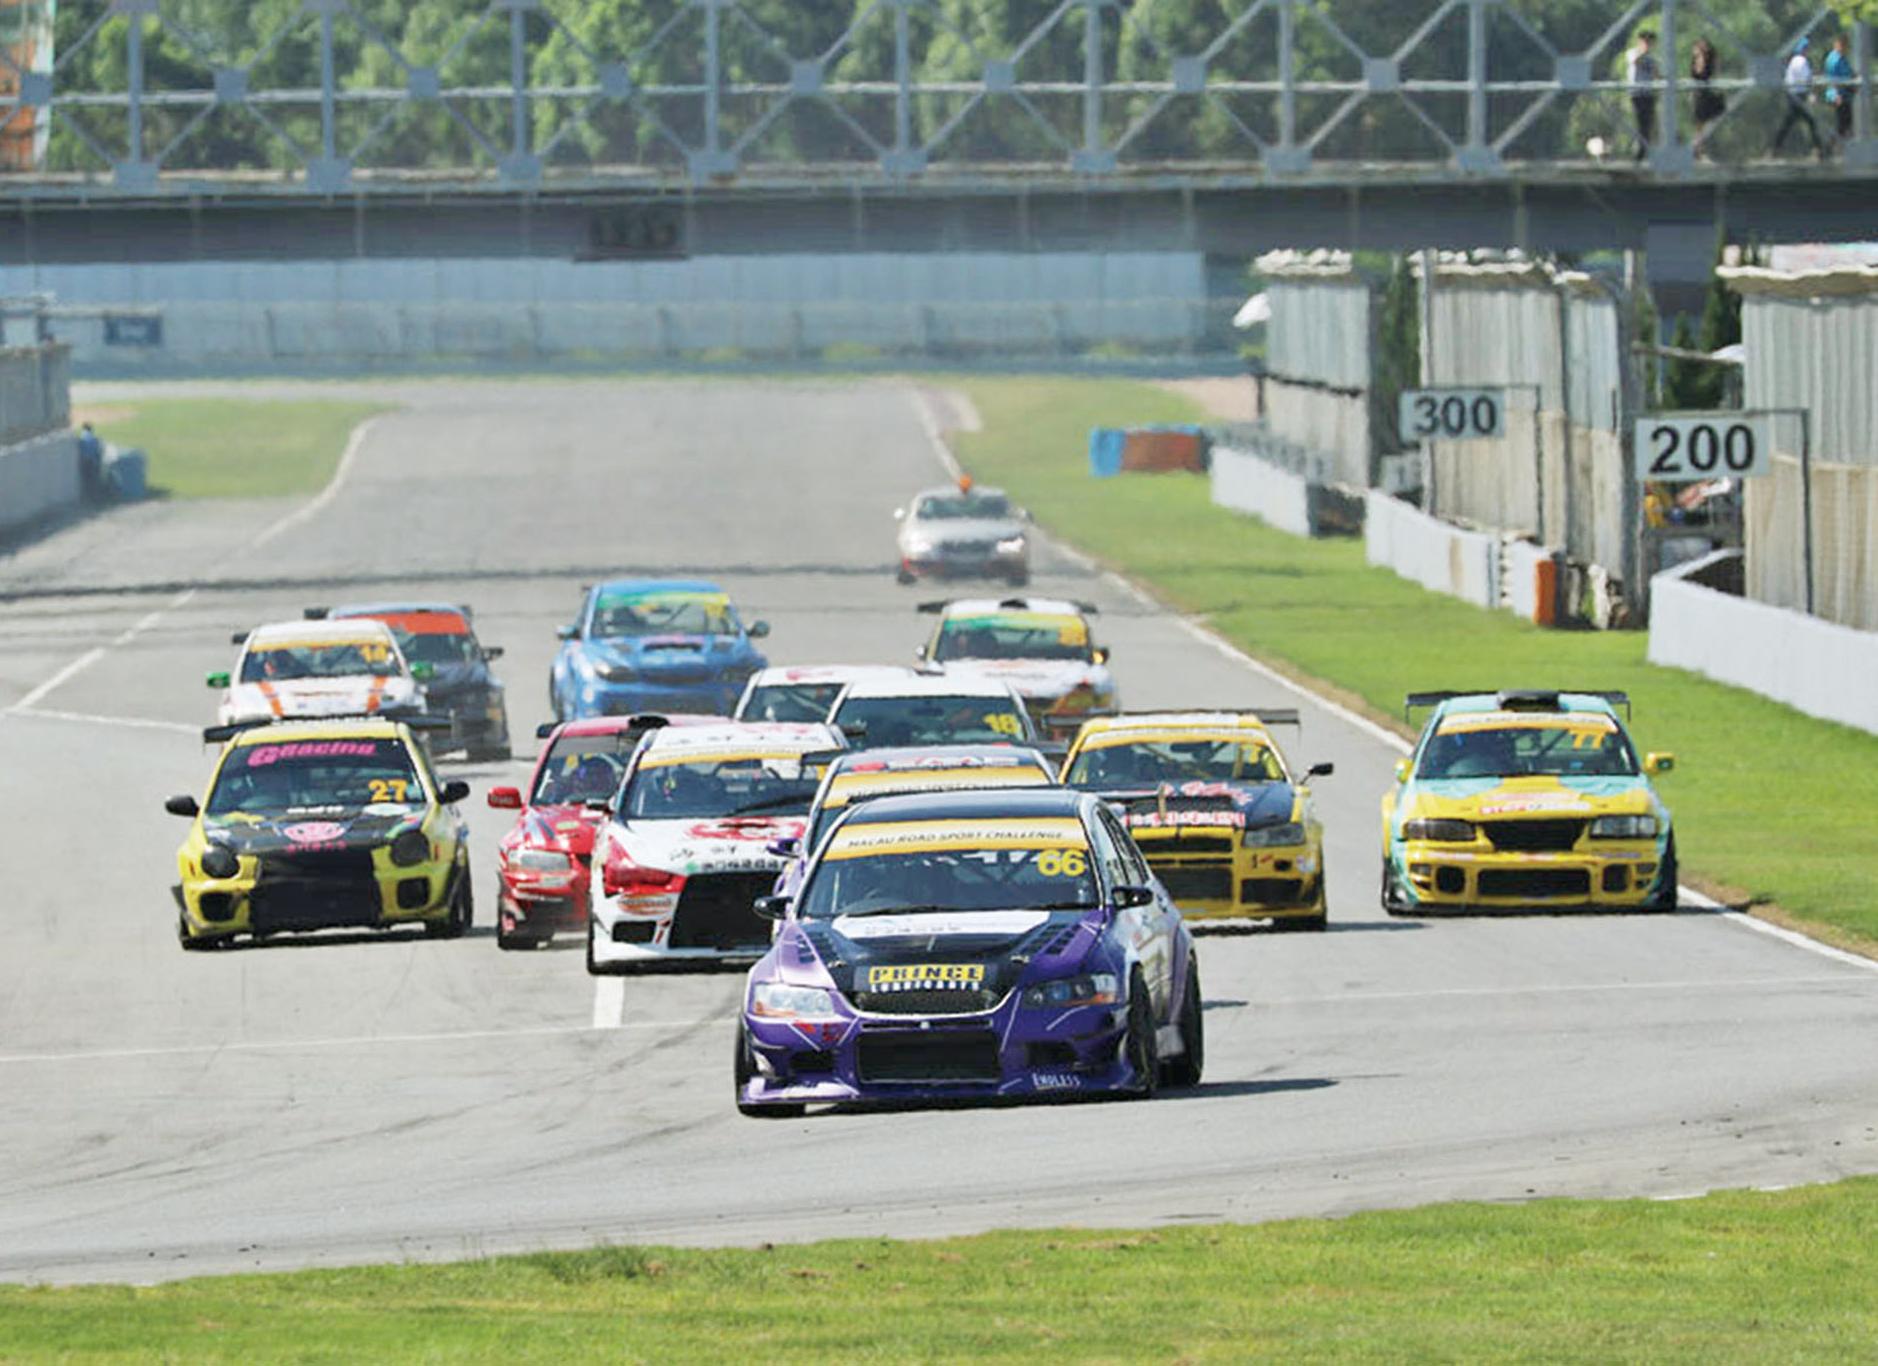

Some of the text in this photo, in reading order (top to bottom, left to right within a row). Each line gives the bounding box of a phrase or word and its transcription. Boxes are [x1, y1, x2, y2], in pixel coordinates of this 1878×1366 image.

[1414, 395, 1497, 437] 300
[1650, 424, 1755, 474] 200
[1568, 729, 1607, 749] 77
[368, 779, 408, 803] 27
[849, 831, 1063, 847] MACAU ROAD SPORT CHALLENGE
[1037, 848, 1086, 877] 66
[871, 964, 982, 982] PRINCE
